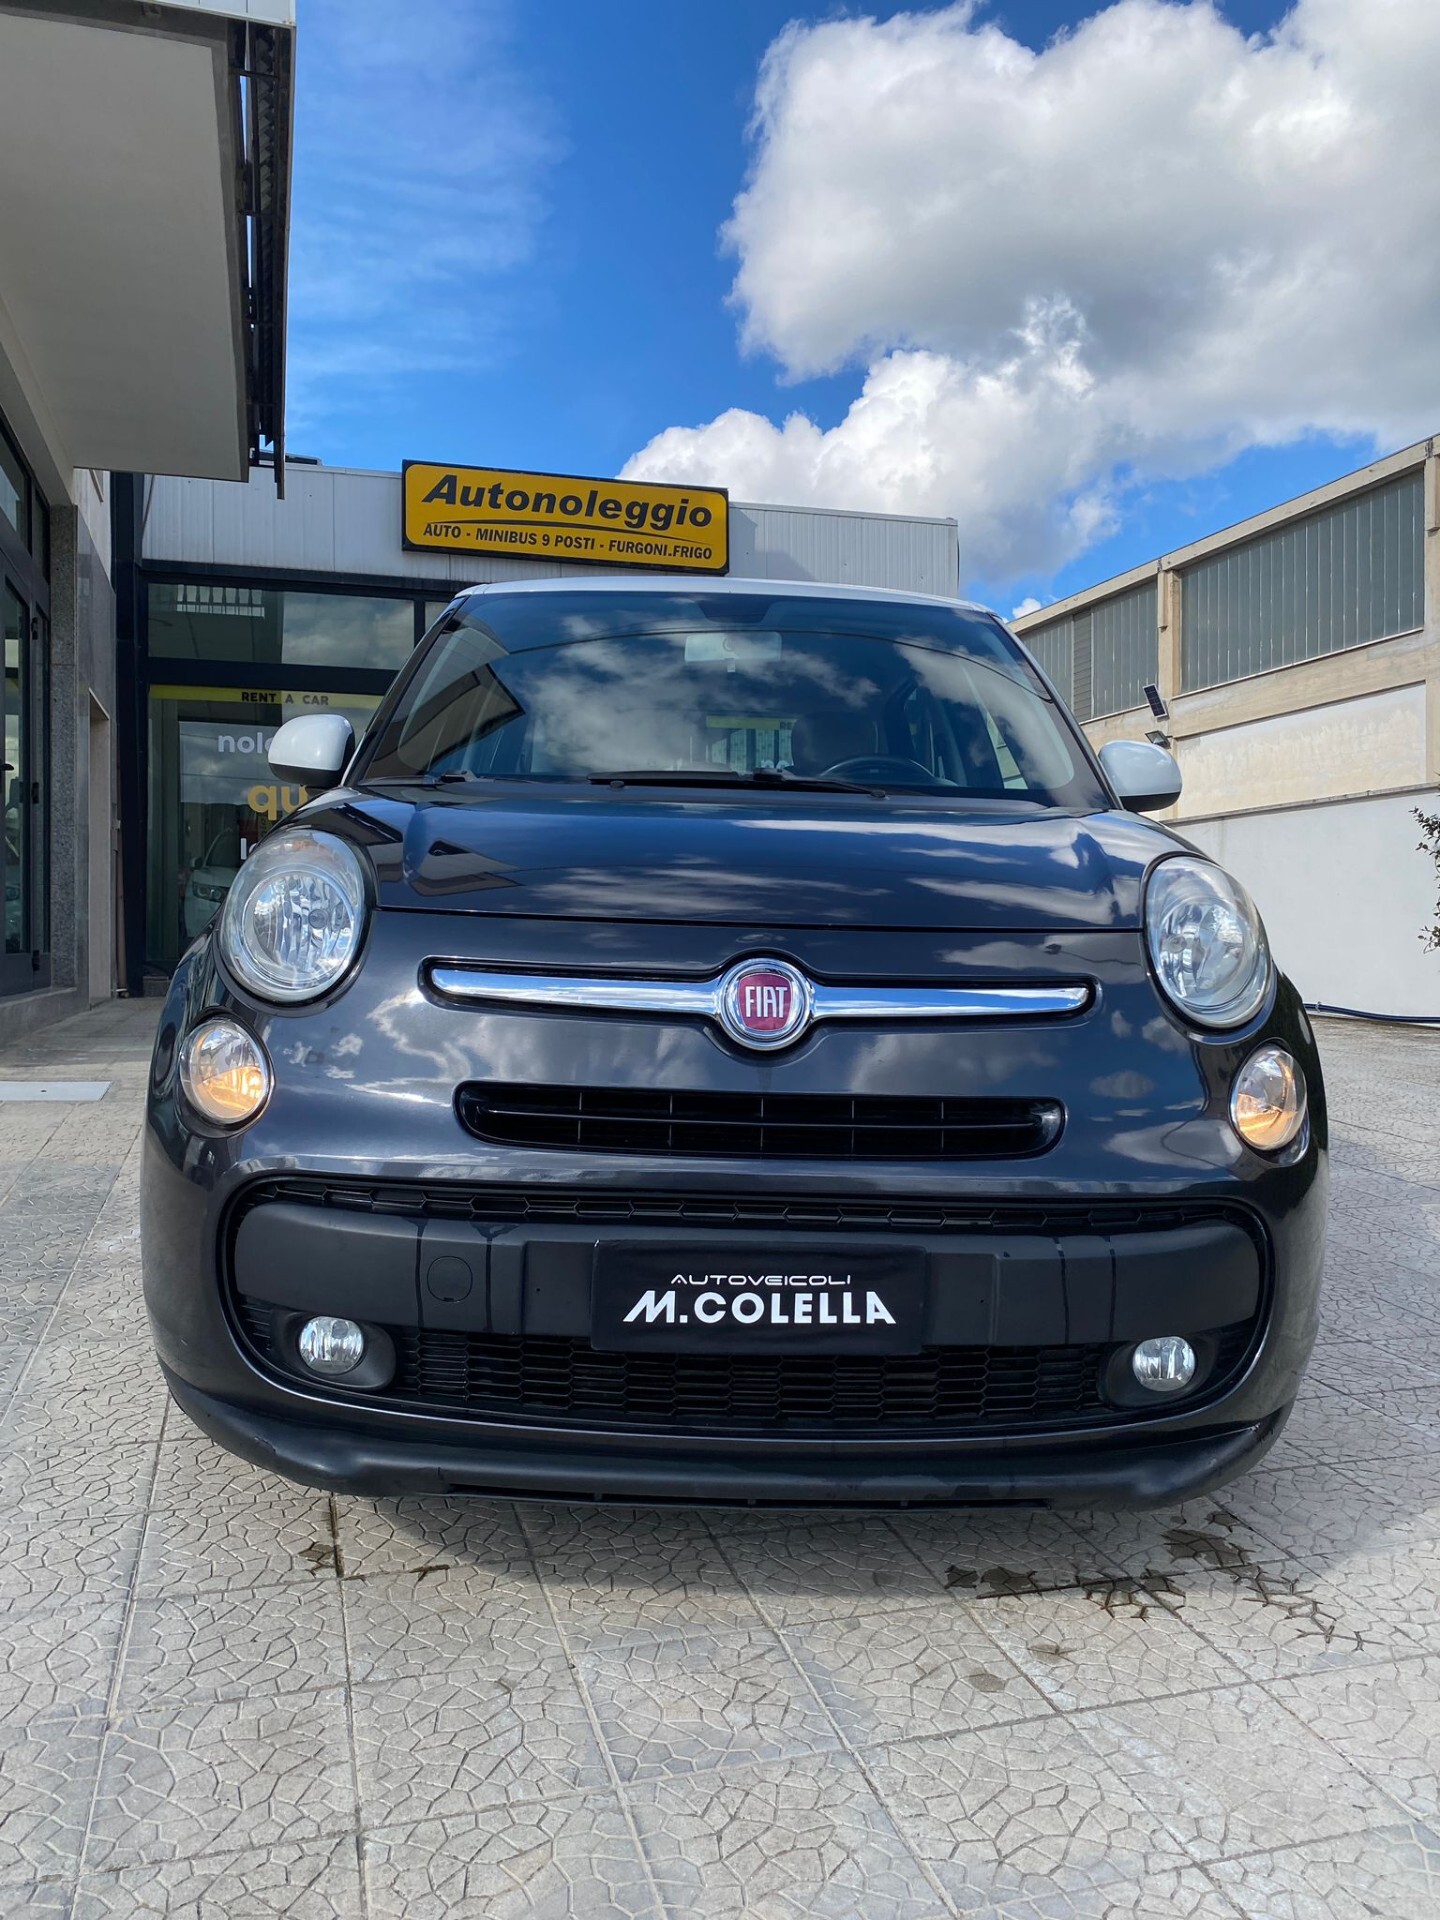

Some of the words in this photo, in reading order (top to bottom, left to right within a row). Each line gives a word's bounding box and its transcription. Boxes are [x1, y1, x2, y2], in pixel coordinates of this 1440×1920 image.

[421, 474, 713, 531] Autonoleggio
[423, 523, 461, 538] AUTO
[475, 528, 537, 545] MINIBUS
[542, 534, 550, 547] 9
[554, 535, 595, 550] POSTI
[241, 692, 276, 703] RENT
[285, 694, 294, 704] A
[303, 695, 329, 706] CAR
[745, 986, 787, 1018] FIAT
[671, 1274, 851, 1286] AUTOVEICOLI
[622, 1290, 897, 1325] M.COLELLA
